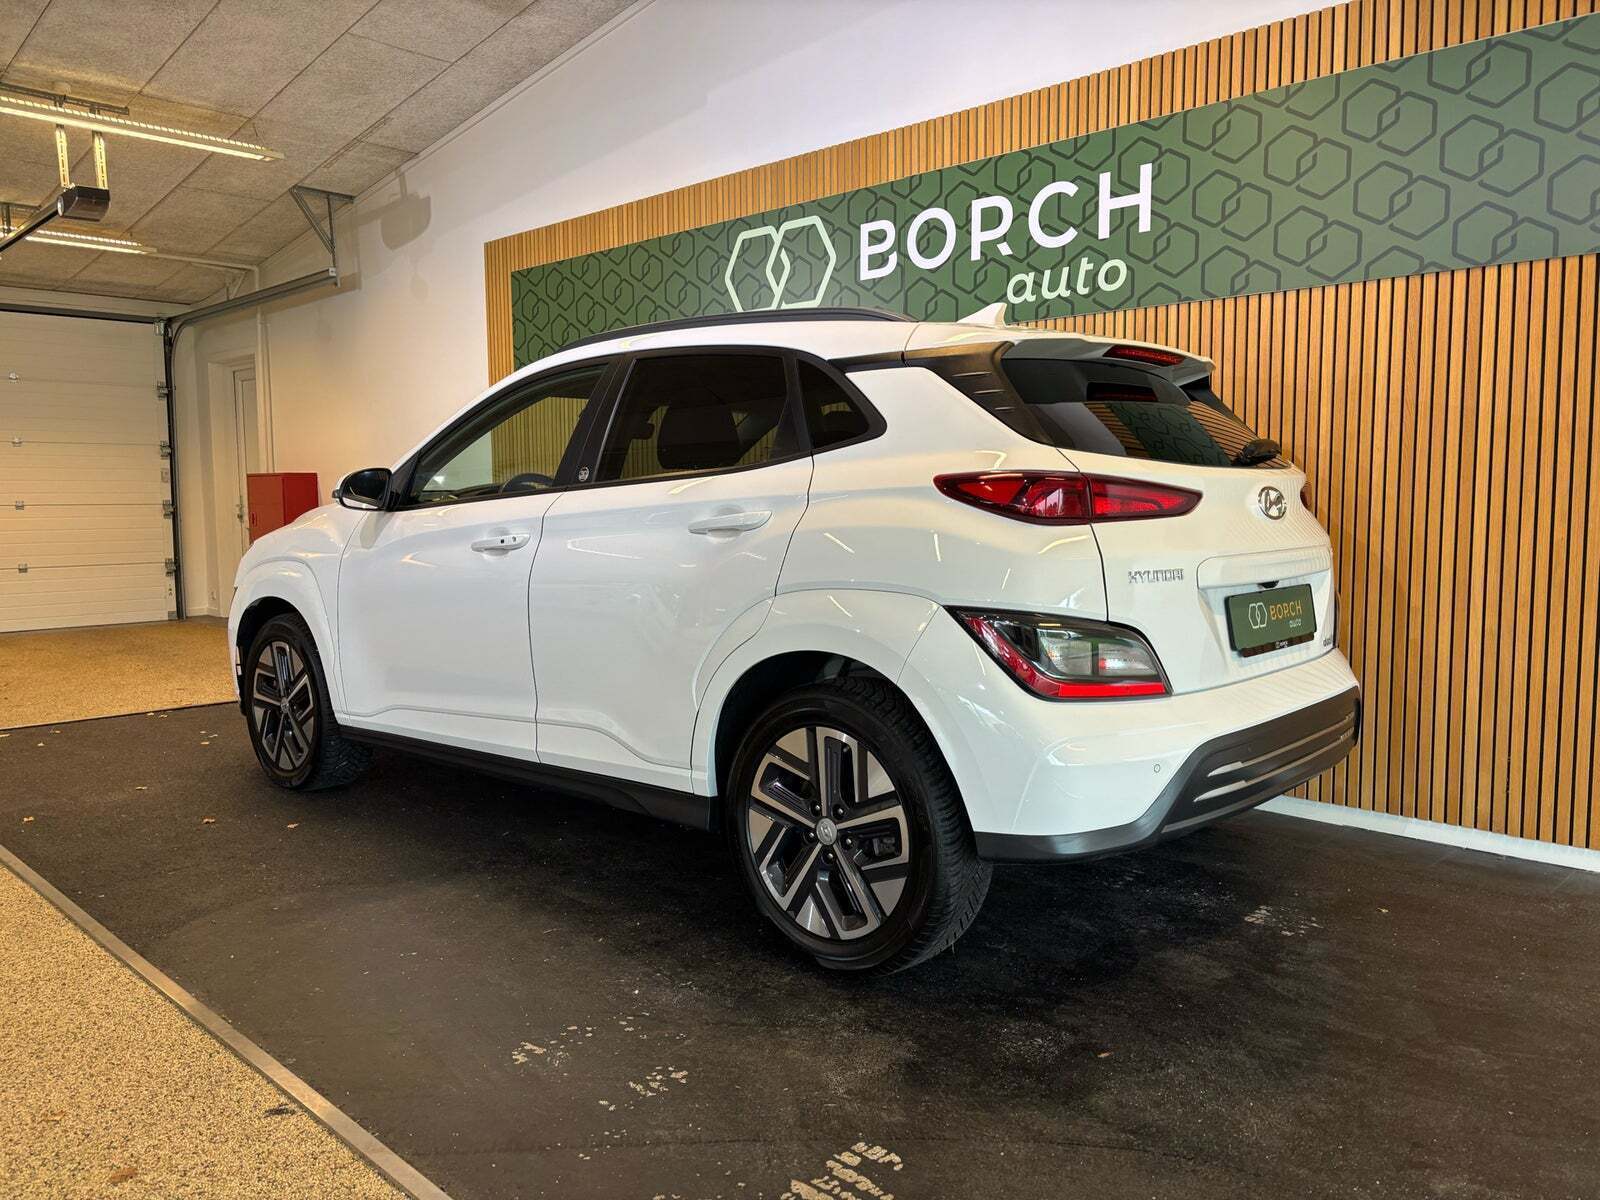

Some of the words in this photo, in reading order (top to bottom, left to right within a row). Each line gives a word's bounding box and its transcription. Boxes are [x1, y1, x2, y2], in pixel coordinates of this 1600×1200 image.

[859, 162, 1153, 281] BORCH
[1006, 256, 1128, 304] auto
[1128, 568, 1184, 584] HYUNDAI
[1269, 600, 1303, 620] BORCH
